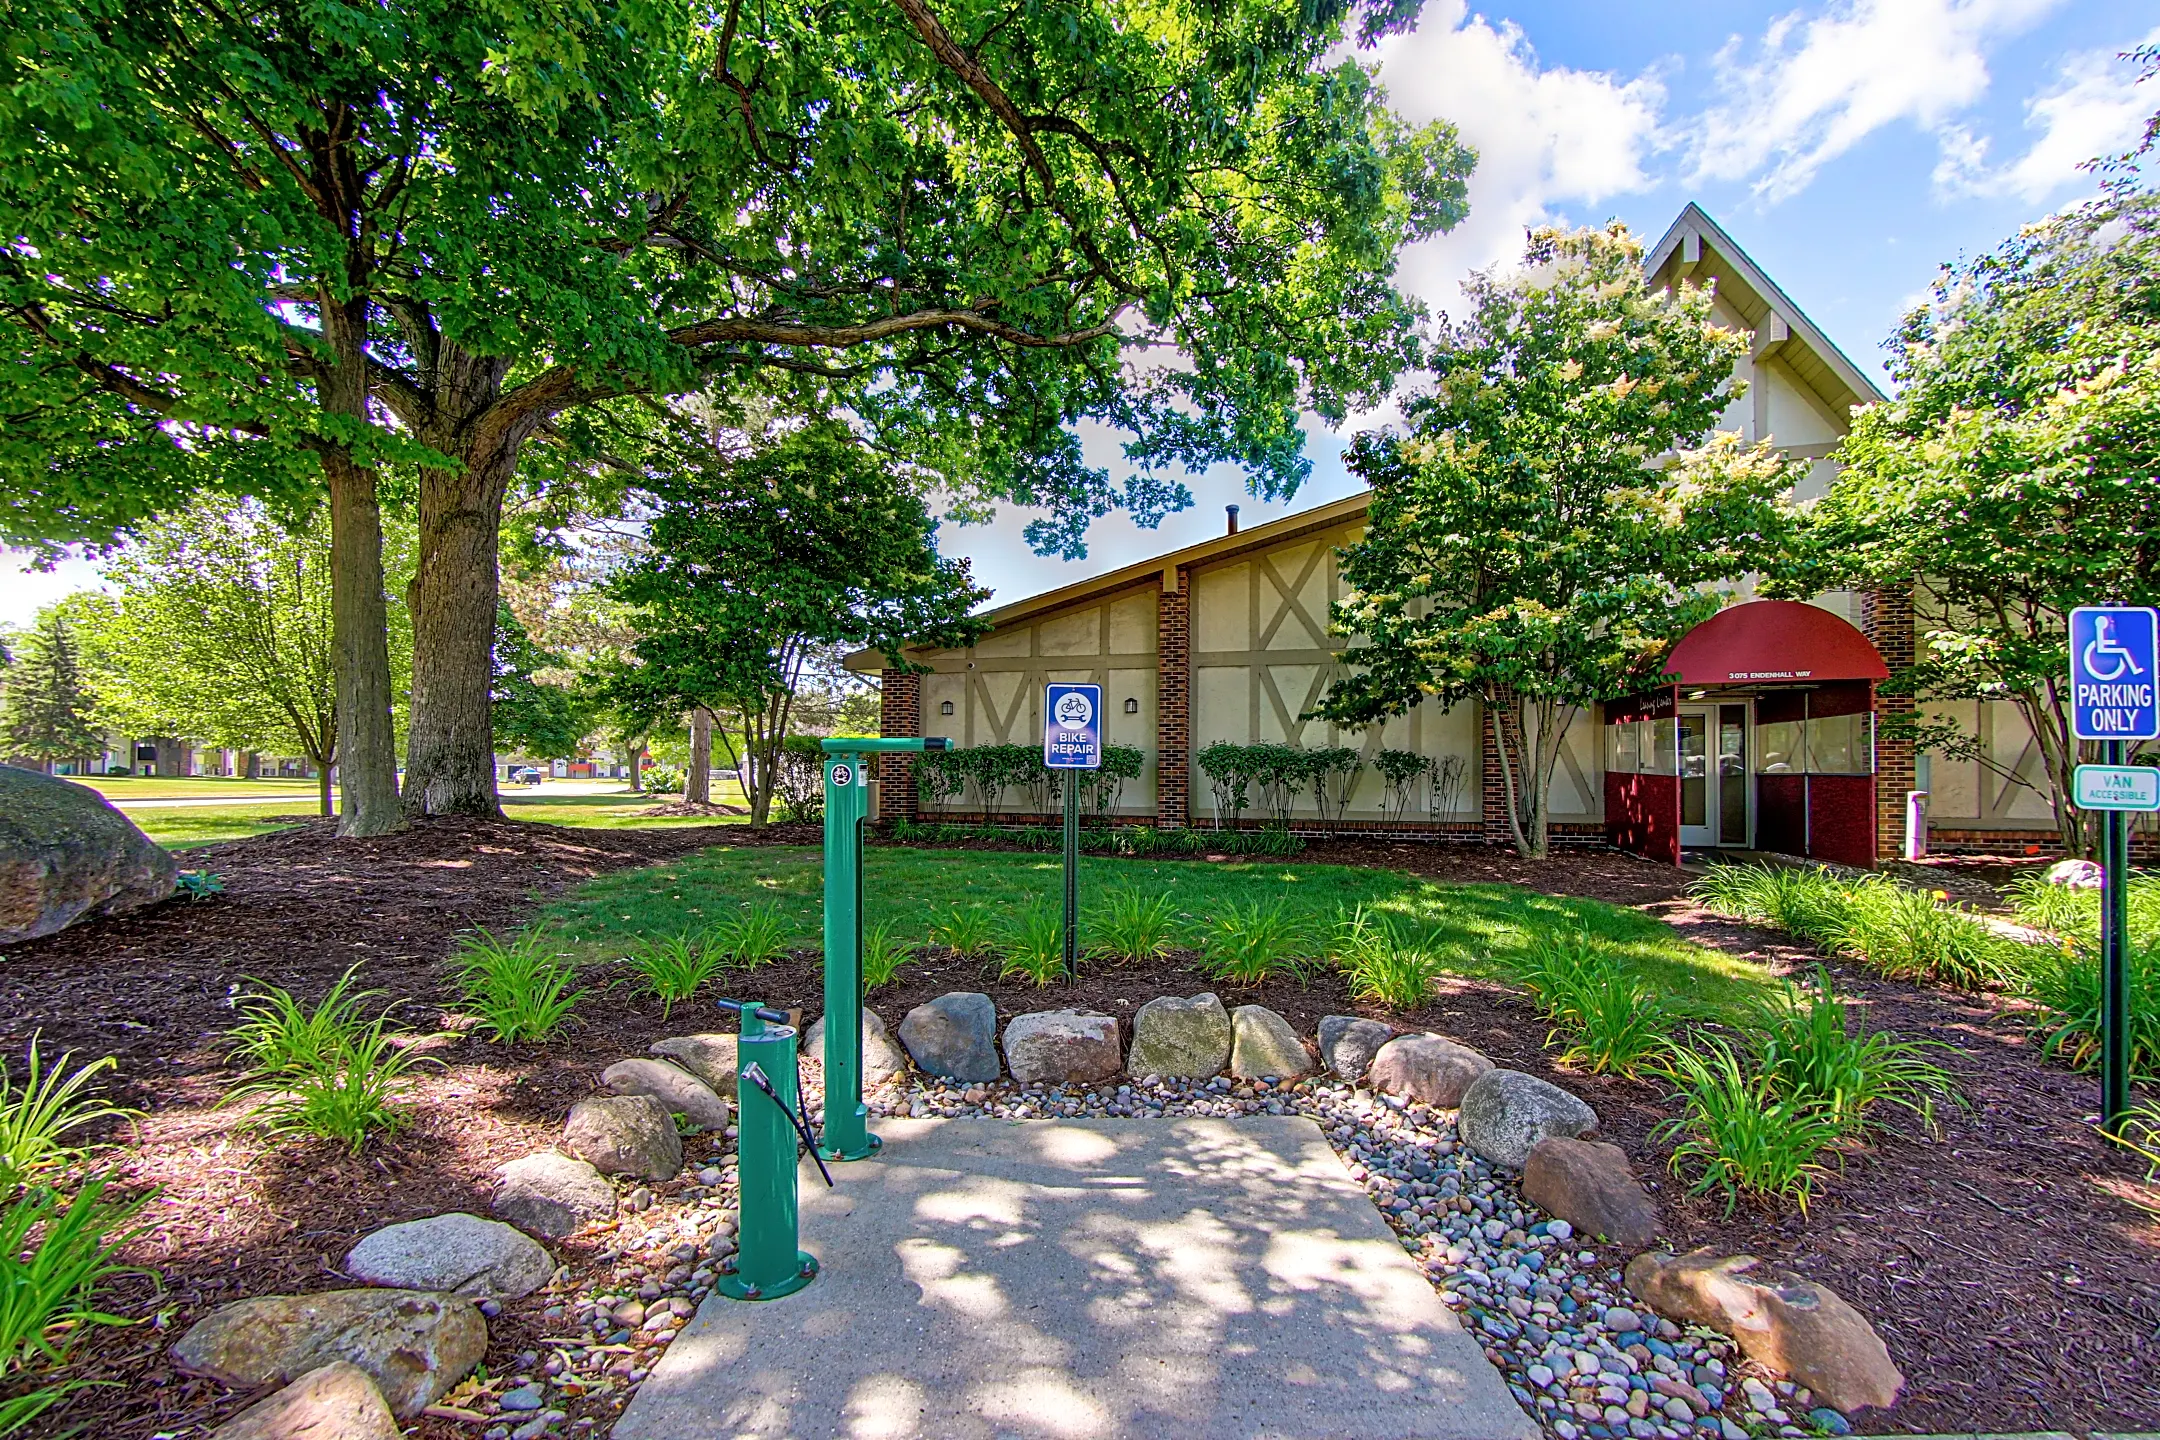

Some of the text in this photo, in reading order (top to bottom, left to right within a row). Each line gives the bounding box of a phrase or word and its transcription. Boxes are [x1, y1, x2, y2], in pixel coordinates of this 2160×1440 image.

[1750, 671, 1793, 679] ENDENHALL
[2078, 684, 2152, 707] PARKING
[2091, 708, 2139, 731] ONLY
[1059, 732, 1087, 743] BIKE
[1051, 744, 1094, 754] REPAIR
[2103, 775, 2132, 788] VAN
[2089, 790, 2147, 800] ACCESSIBLE
